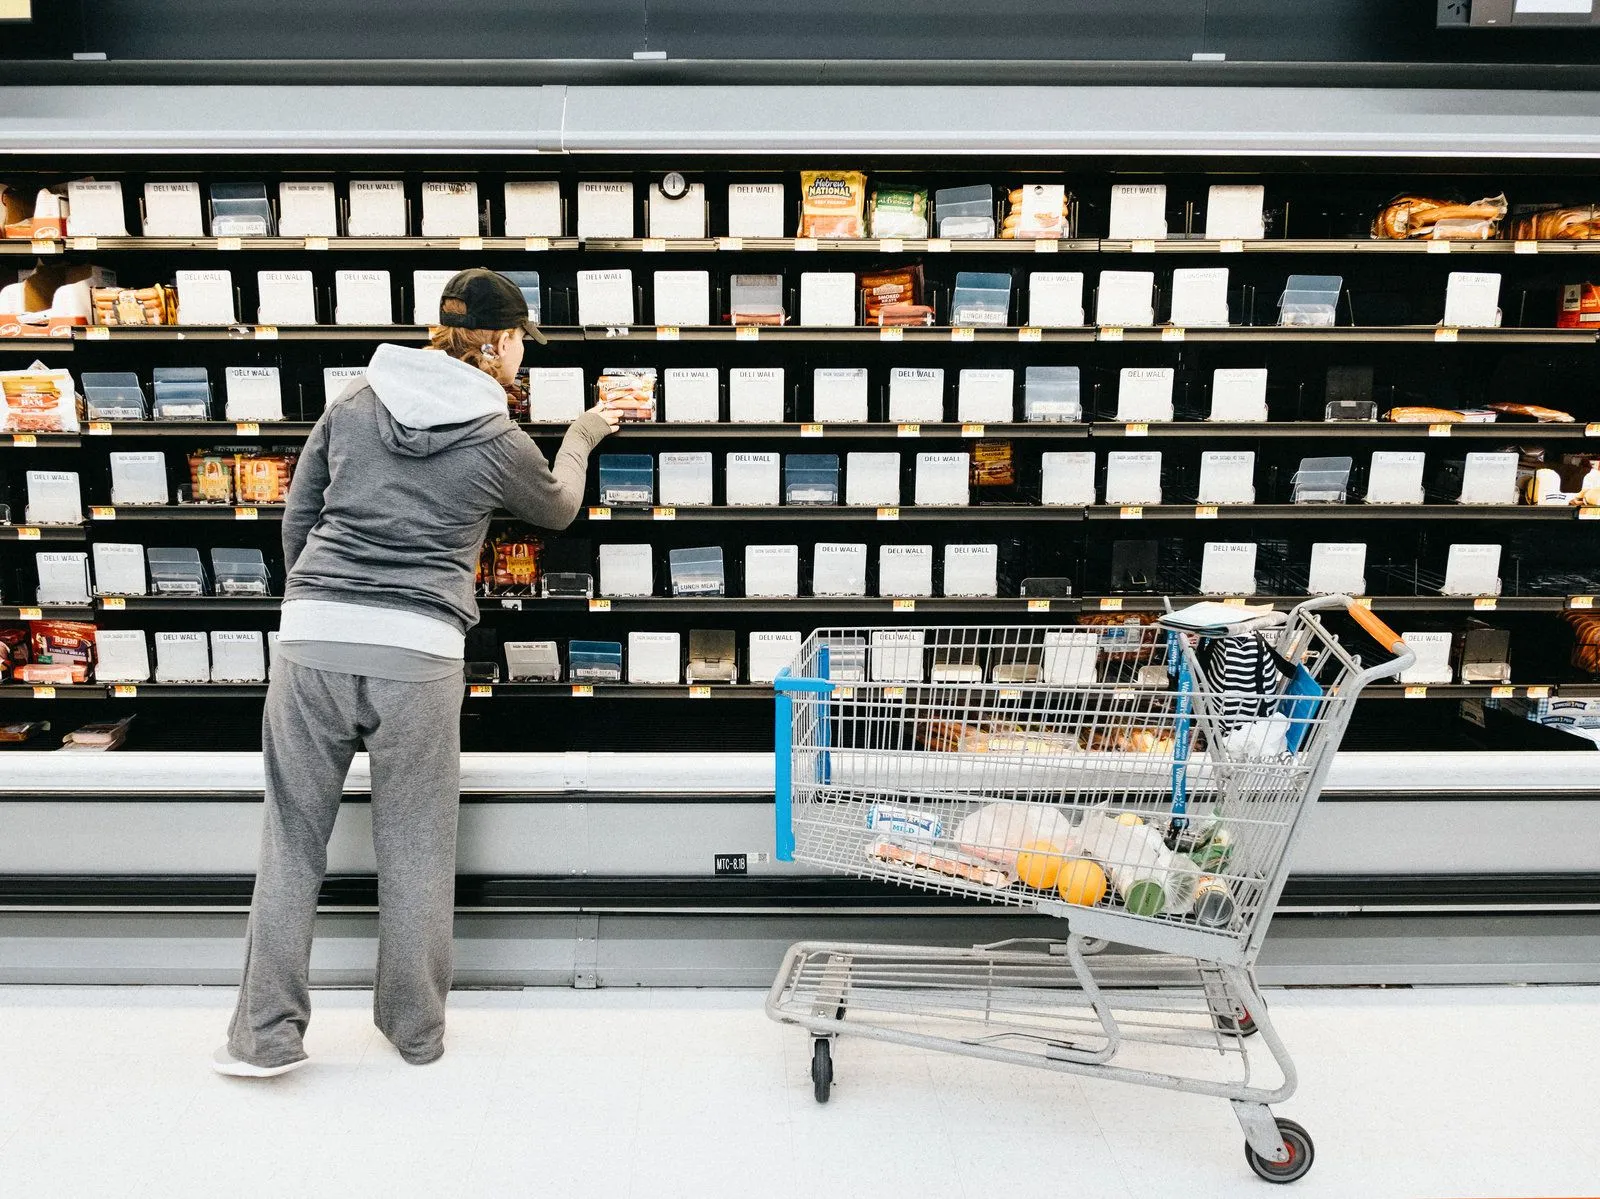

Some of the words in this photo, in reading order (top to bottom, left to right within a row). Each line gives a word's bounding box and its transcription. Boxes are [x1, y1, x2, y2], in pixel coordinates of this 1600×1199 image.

[815, 178, 844, 187] Hebrew
[430, 184, 446, 192] DELI
[448, 184, 468, 192] WALL
[809, 187, 850, 196] NATIONAL
[54, 636, 78, 645] Bryan
[716, 858, 746, 870] MTC-8.1B
